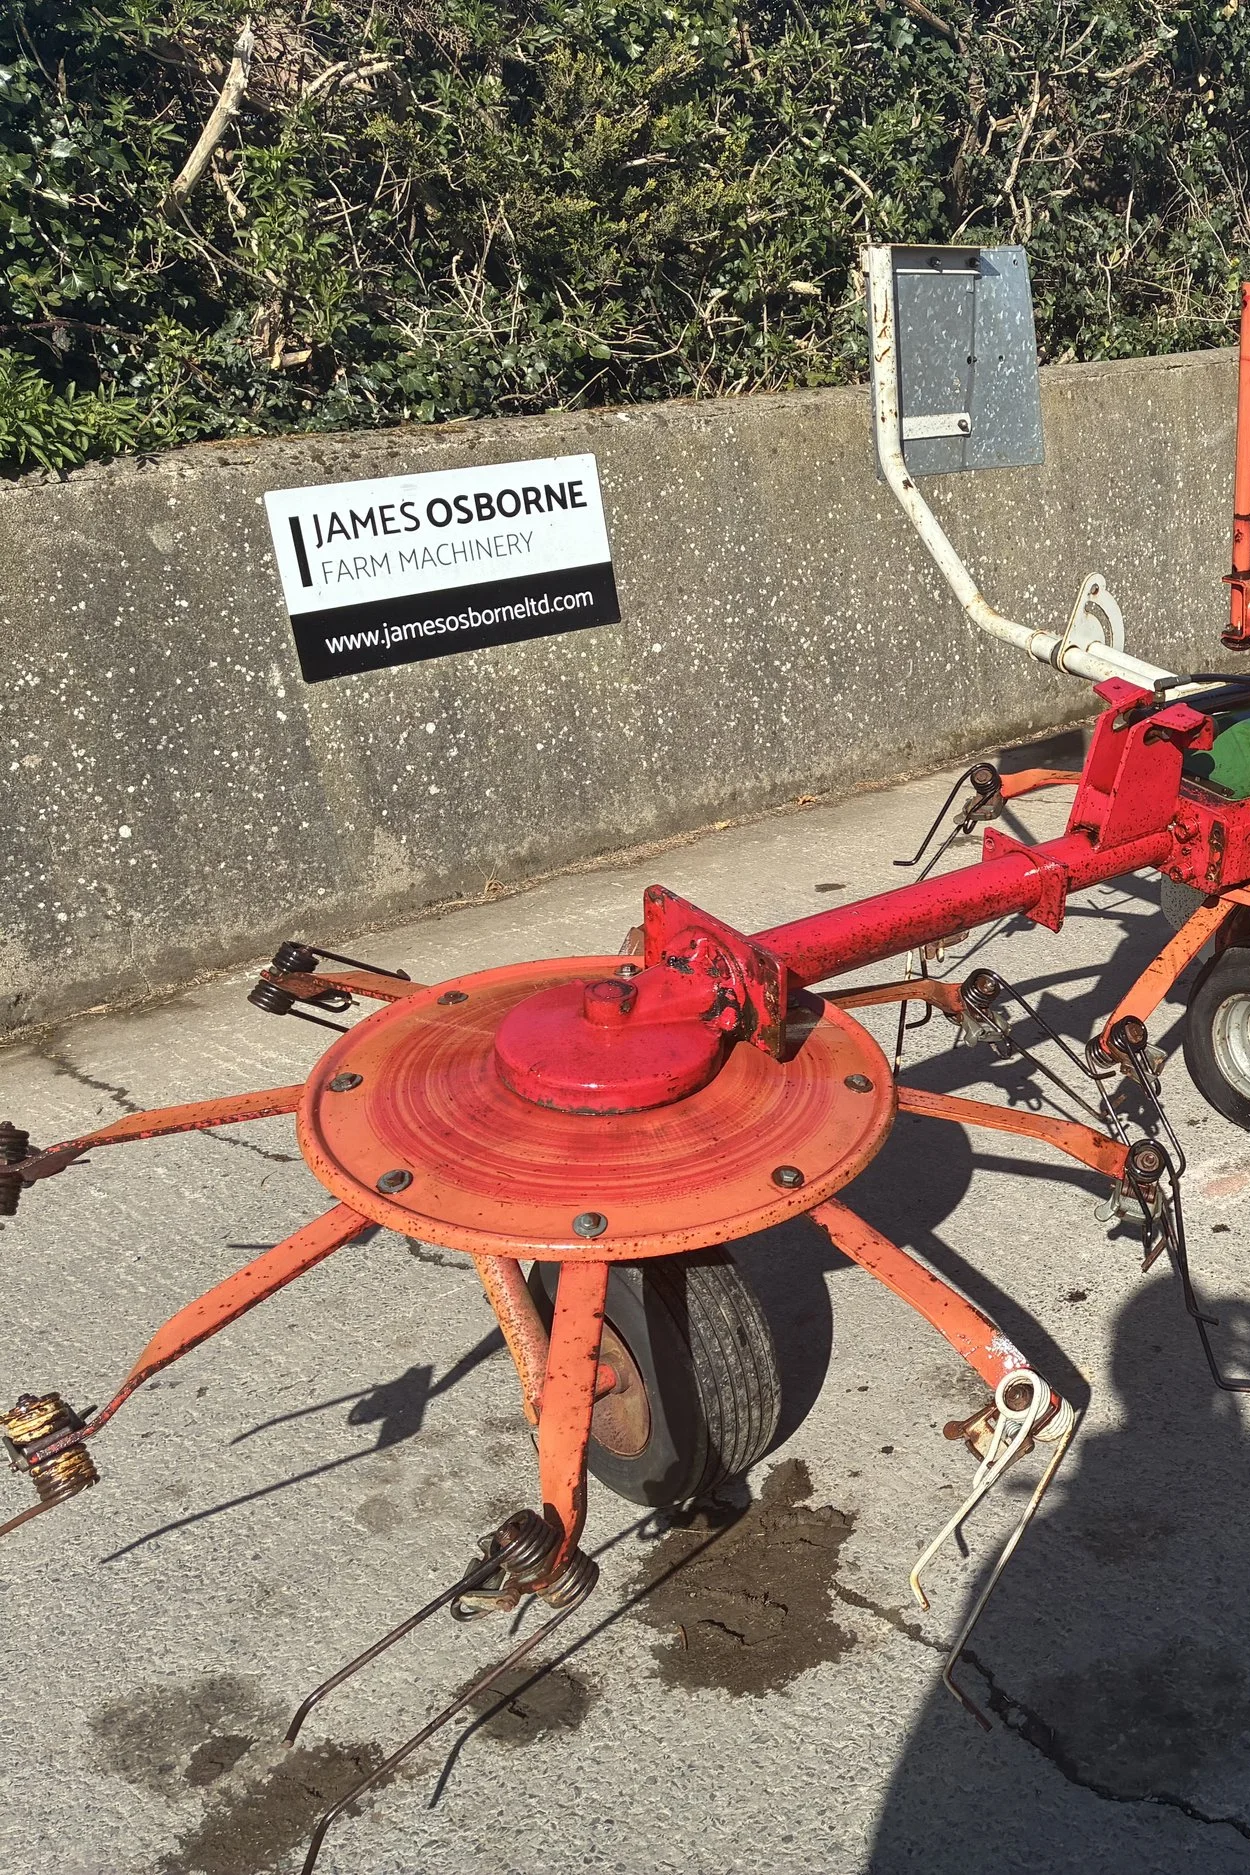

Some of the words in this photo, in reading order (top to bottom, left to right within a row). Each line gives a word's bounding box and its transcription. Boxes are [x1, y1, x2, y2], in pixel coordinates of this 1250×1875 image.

[312, 501, 421, 549] JAMES
[426, 480, 588, 528] OSBORNE
[321, 553, 392, 585] FARM
[399, 531, 534, 573] MACHINERY
[325, 590, 594, 655] www.jamesosborneltd.com
